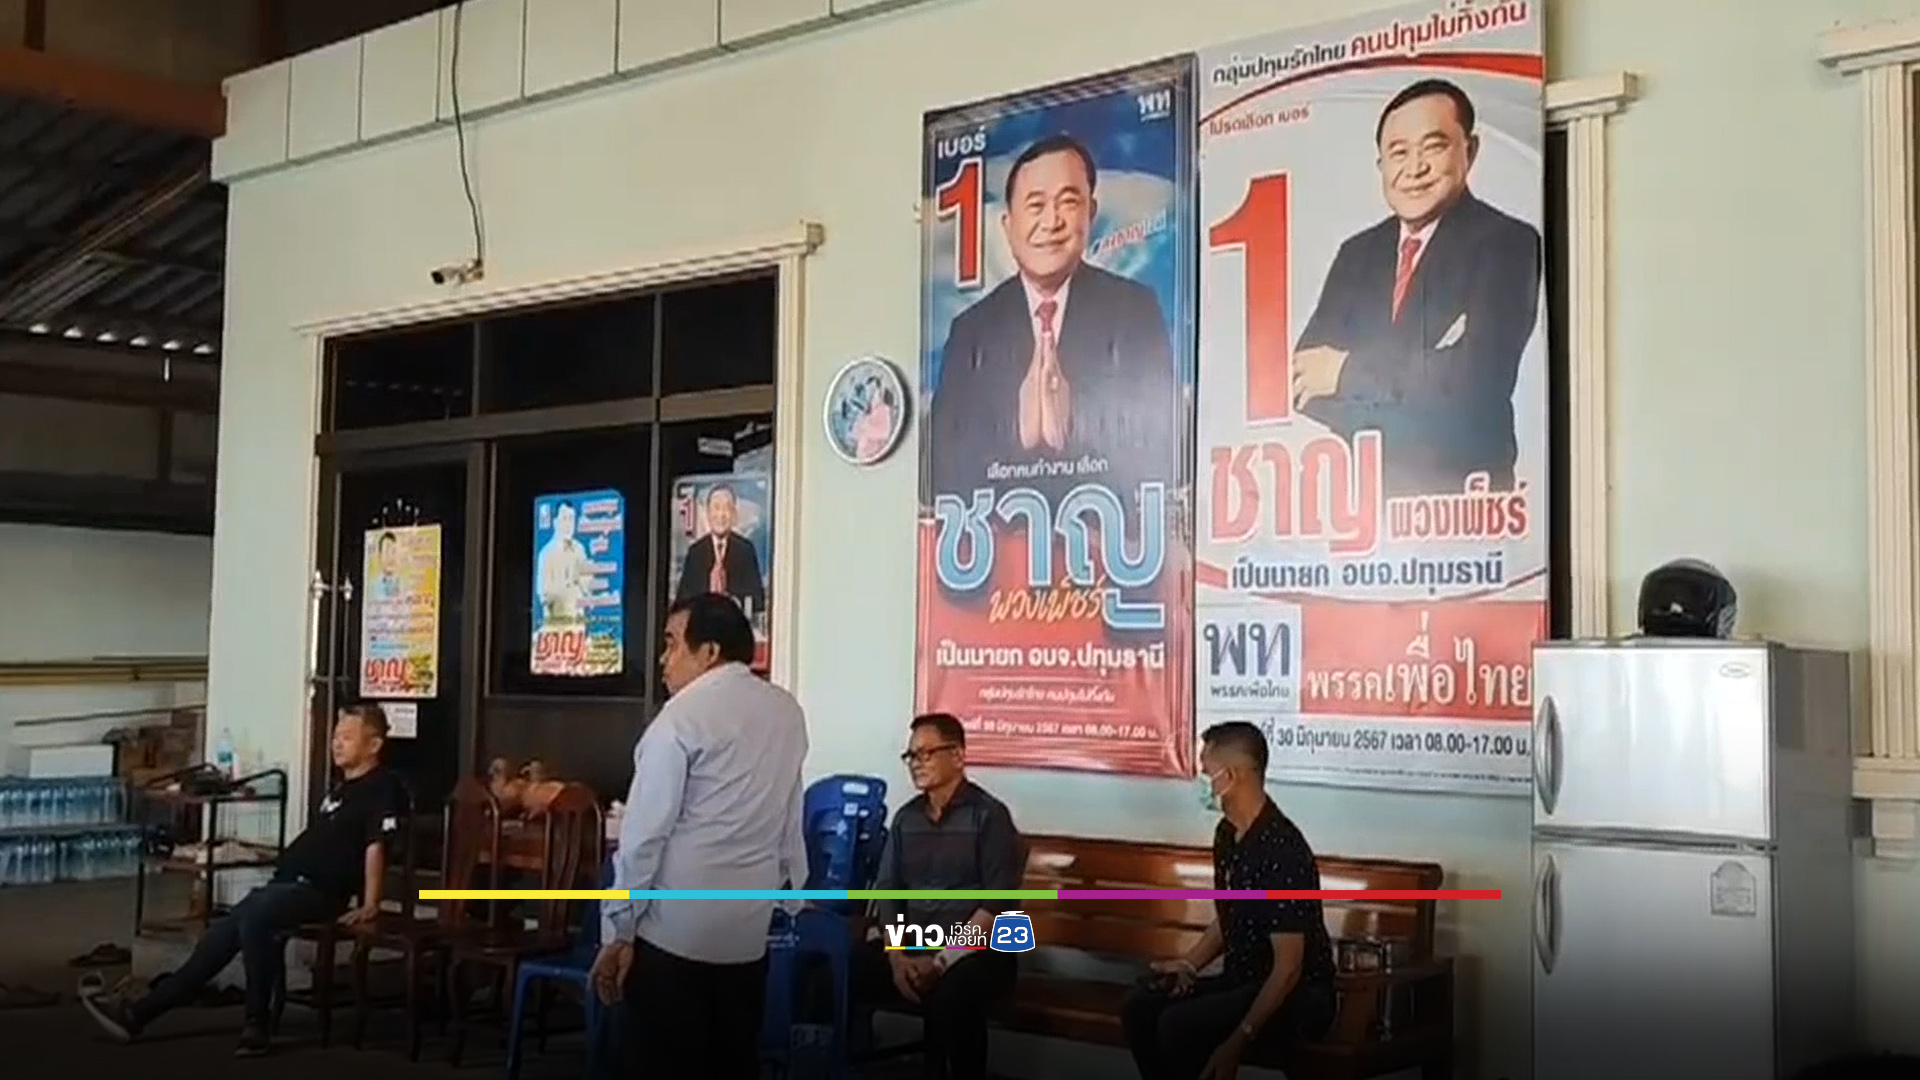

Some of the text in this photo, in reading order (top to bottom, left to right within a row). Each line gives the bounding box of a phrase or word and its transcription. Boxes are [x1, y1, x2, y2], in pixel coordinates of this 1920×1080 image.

[1213, 42, 1346, 85] กลุ่มปทุมรักไทย
[1137, 89, 1171, 113] พท
[1278, 103, 1311, 123] เบอร์
[937, 126, 986, 159] เบอร์
[937, 159, 981, 288] 1
[1209, 171, 1292, 424] 1
[1211, 430, 1382, 555] ชาญ
[1389, 474, 1528, 540] พวงเพ็ชร์
[934, 482, 1166, 629] ชาญ
[1232, 552, 1503, 594] เป็นนายก อบจ.ปทุมธานี
[936, 640, 1165, 676] เป็นนายก อบจ.ปทุมธานี
[1204, 623, 1290, 676] พท
[1306, 611, 1532, 708] พรรคเพื่อไทย
[1277, 728, 1293, 747] 30
[1296, 725, 1350, 753] มิถุนายน
[1354, 731, 1388, 751] 2567
[1391, 733, 1422, 752] เวลา
[1425, 733, 1513, 756] 08.00-17.00
[1516, 741, 1531, 756] น.
